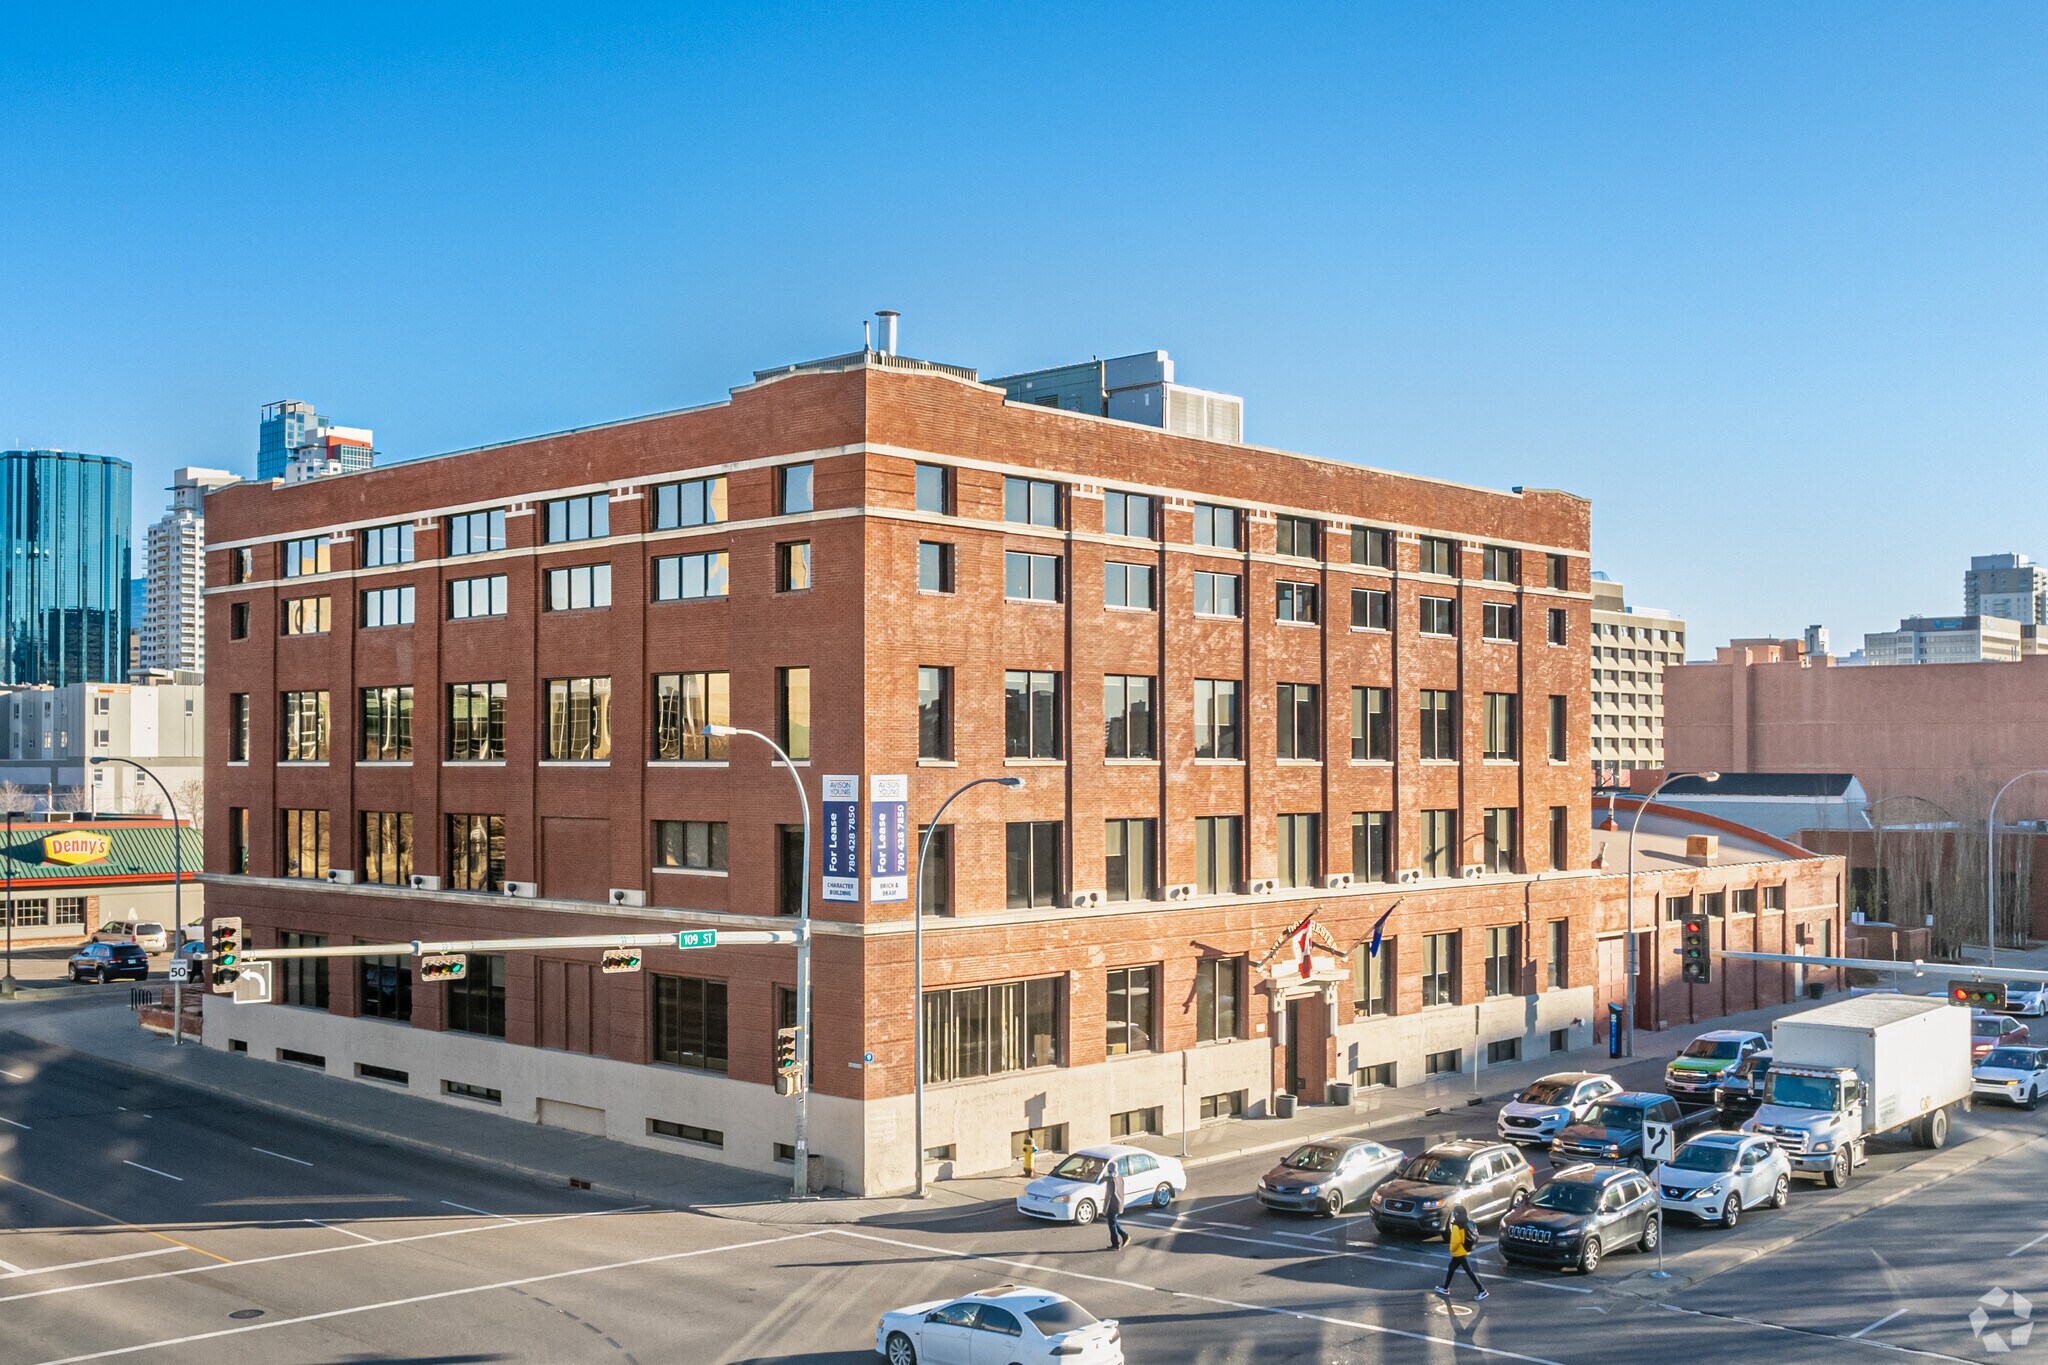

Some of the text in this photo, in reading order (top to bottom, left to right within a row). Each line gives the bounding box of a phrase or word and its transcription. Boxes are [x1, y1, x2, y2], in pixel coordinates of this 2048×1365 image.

[52, 838, 106, 854] Denny's
[829, 813, 838, 872] For Lease
[878, 813, 886, 873] For Lease
[684, 933, 712, 945] 109 ST
[171, 967, 186, 977] 50
